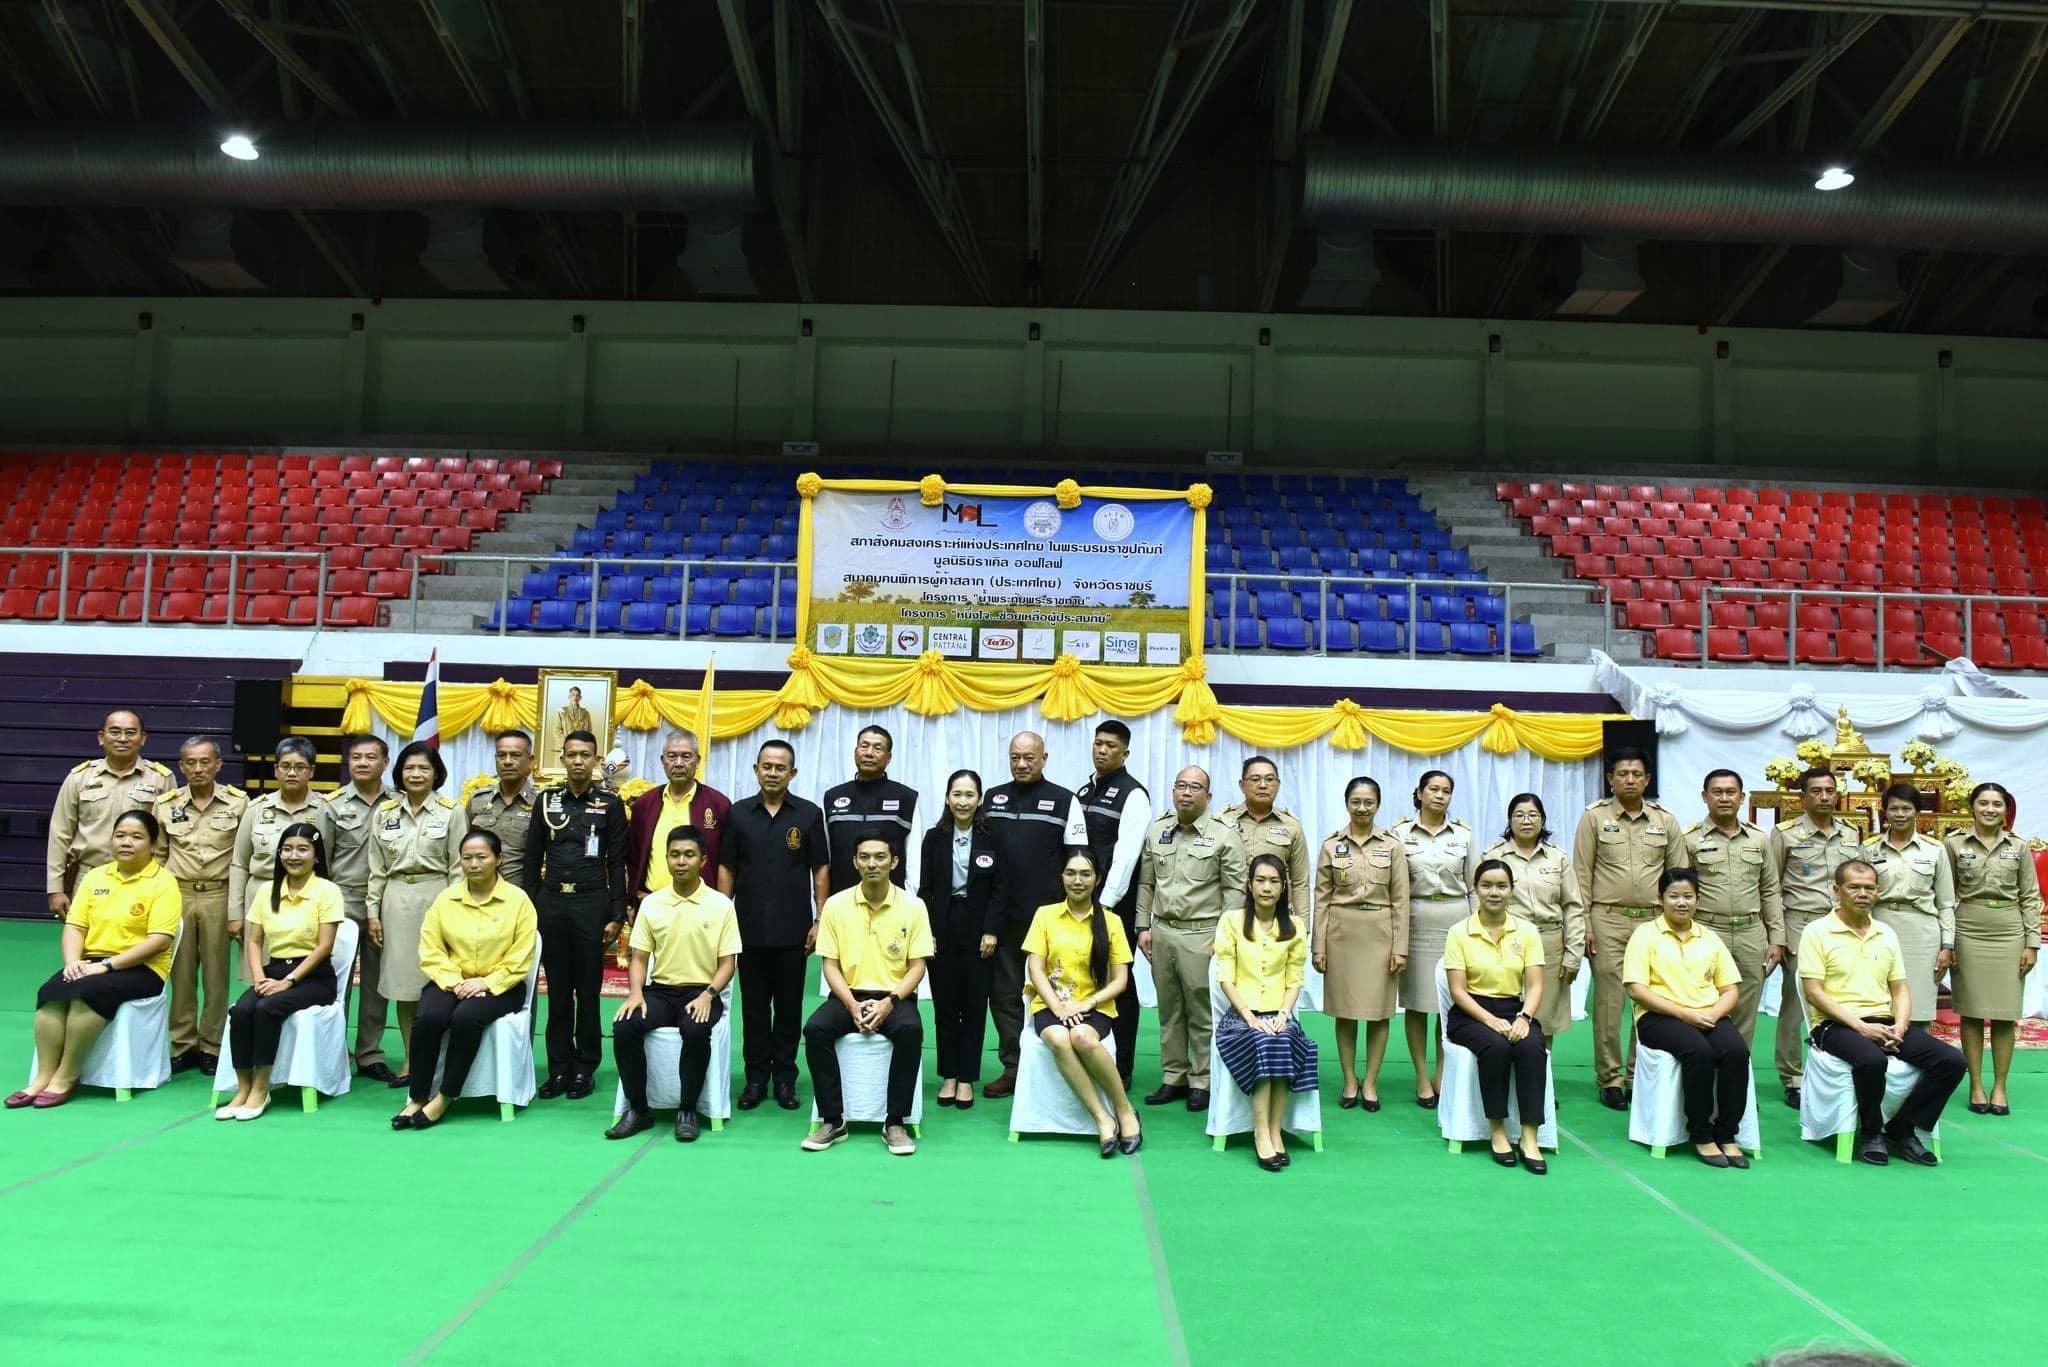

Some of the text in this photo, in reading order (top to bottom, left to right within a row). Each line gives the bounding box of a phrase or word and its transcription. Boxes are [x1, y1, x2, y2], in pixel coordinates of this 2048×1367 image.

[850, 534, 1163, 558] สภาสังคมสงเคราะห์แห่งประเทศไทย ในพระบรมราชูปถัมภ์
[1014, 556, 1063, 569] ออฟไลฟ์
[843, 571, 1153, 593] สมาคมคนพิการผู้ค้าสลาก (ประเทศไทย) จังหวัดราชบุรี
[922, 591, 968, 602] โครงการ
[901, 607, 946, 619] โครงการ
[933, 632, 968, 641] CENTRAL
[933, 641, 968, 650] PATTANA
[1105, 636, 1138, 651] Sing
